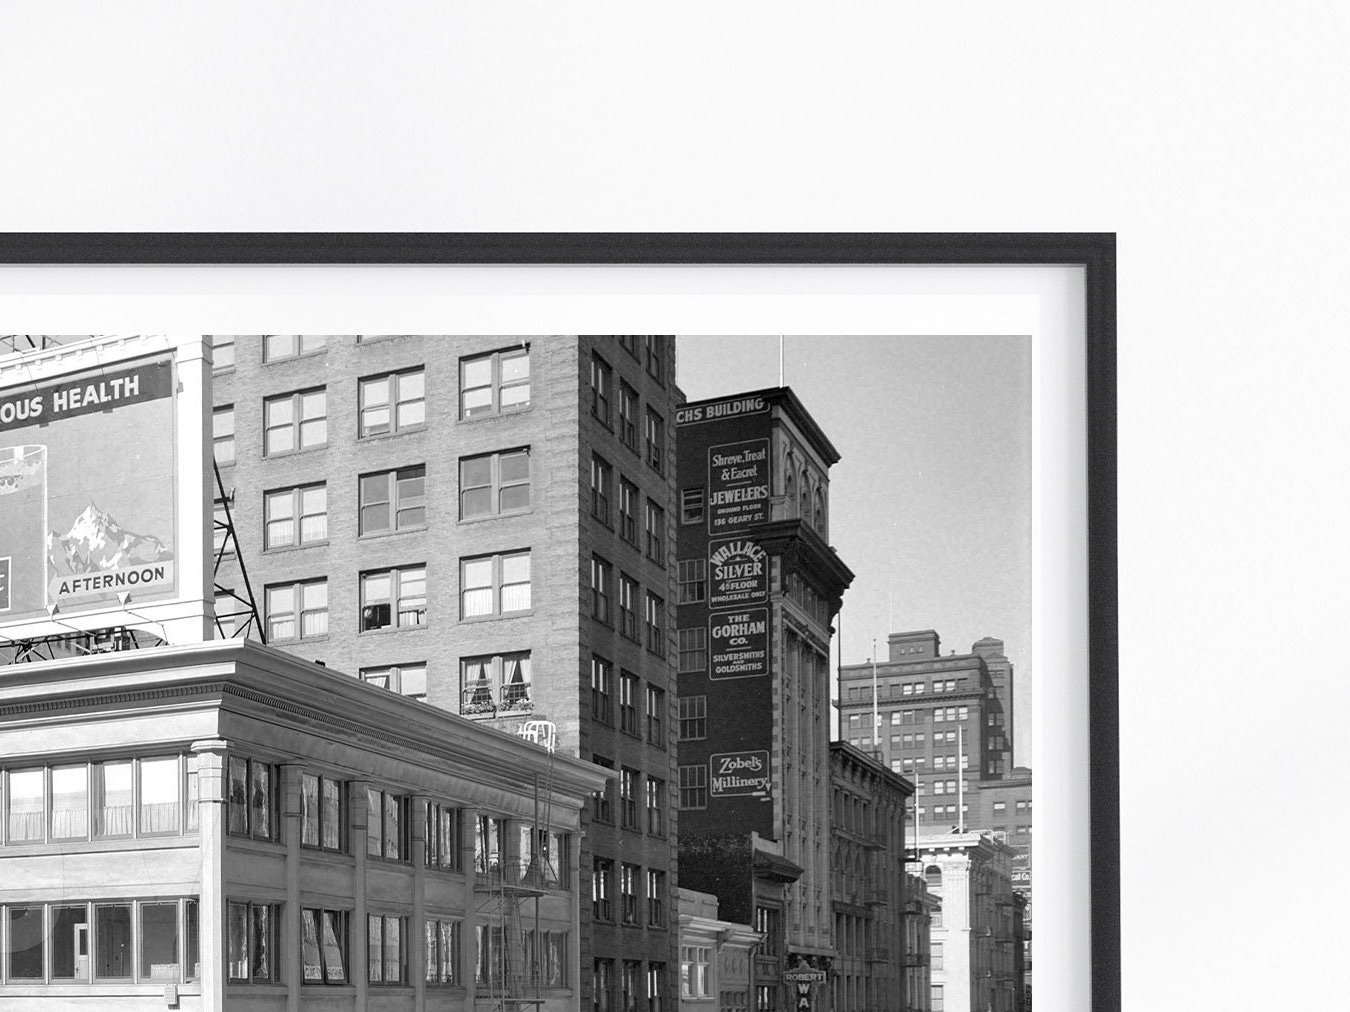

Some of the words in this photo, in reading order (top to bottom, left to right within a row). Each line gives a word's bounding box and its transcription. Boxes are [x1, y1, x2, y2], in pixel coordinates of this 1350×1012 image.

[53, 375, 139, 412] HEALTH
[676, 408, 702, 424] CHS
[706, 398, 764, 419] BUILDING
[744, 448, 766, 461] Treat
[722, 468, 730, 480] &
[731, 465, 757, 479] Eacret
[710, 485, 768, 505] JEWELERS
[717, 506, 741, 514] GROUND
[742, 503, 761, 511] FLOOR
[728, 514, 752, 524] GEARY
[710, 541, 767, 566] WALLACE
[715, 562, 762, 580] SILVER
[58, 566, 165, 594] AFTERNOON
[731, 580, 758, 589] FLOOR
[711, 593, 750, 602] WHOLESALE
[728, 614, 750, 623] THE
[712, 621, 765, 638] GORHAM
[729, 637, 748, 645] CO.
[713, 651, 765, 662] SILVERSMITHS
[715, 662, 762, 673] GOLDSMITHS
[719, 756, 763, 774] Zobel's
[712, 776, 768, 793] Millinery
[785, 973, 823, 981] ROBERT
